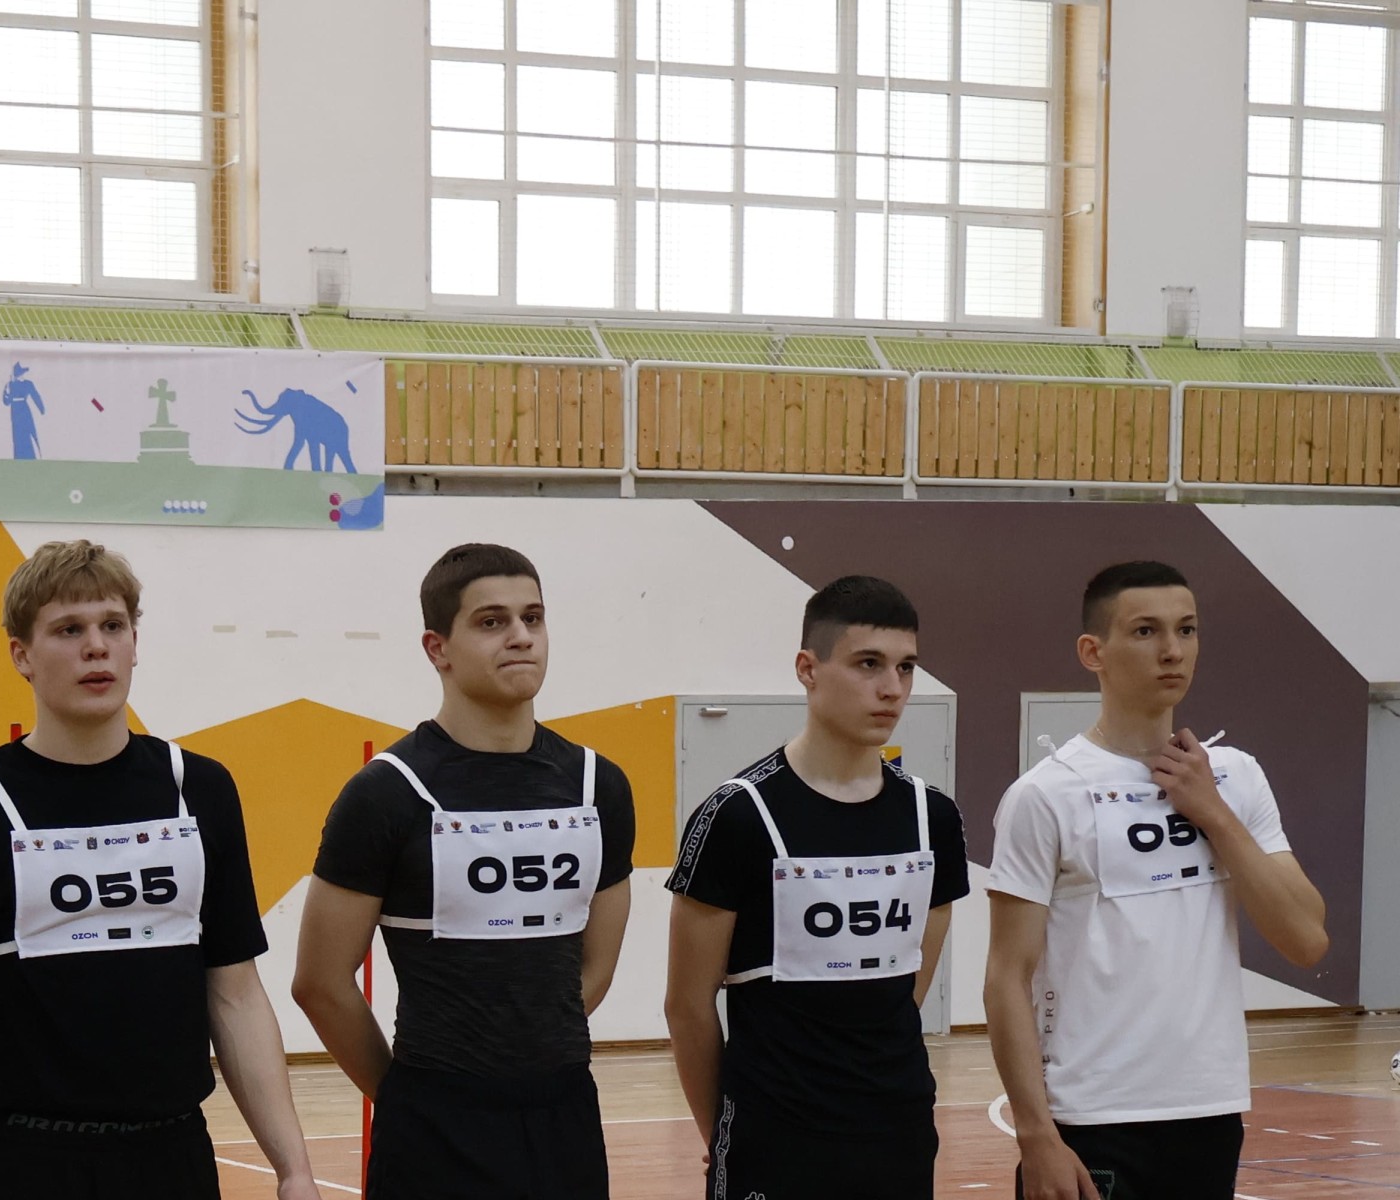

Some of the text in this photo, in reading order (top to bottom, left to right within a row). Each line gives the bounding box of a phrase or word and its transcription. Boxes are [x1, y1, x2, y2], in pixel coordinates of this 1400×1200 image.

[682, 815, 711, 868] Kappa
[1127, 813, 1209, 853] 05
[50, 865, 178, 914] 055
[467, 853, 580, 894] 052
[1151, 872, 1173, 882] OZON
[71, 932, 99, 940] OZON
[488, 919, 514, 927] OZON
[803, 898, 912, 938] 054
[826, 961, 852, 969] OZON
